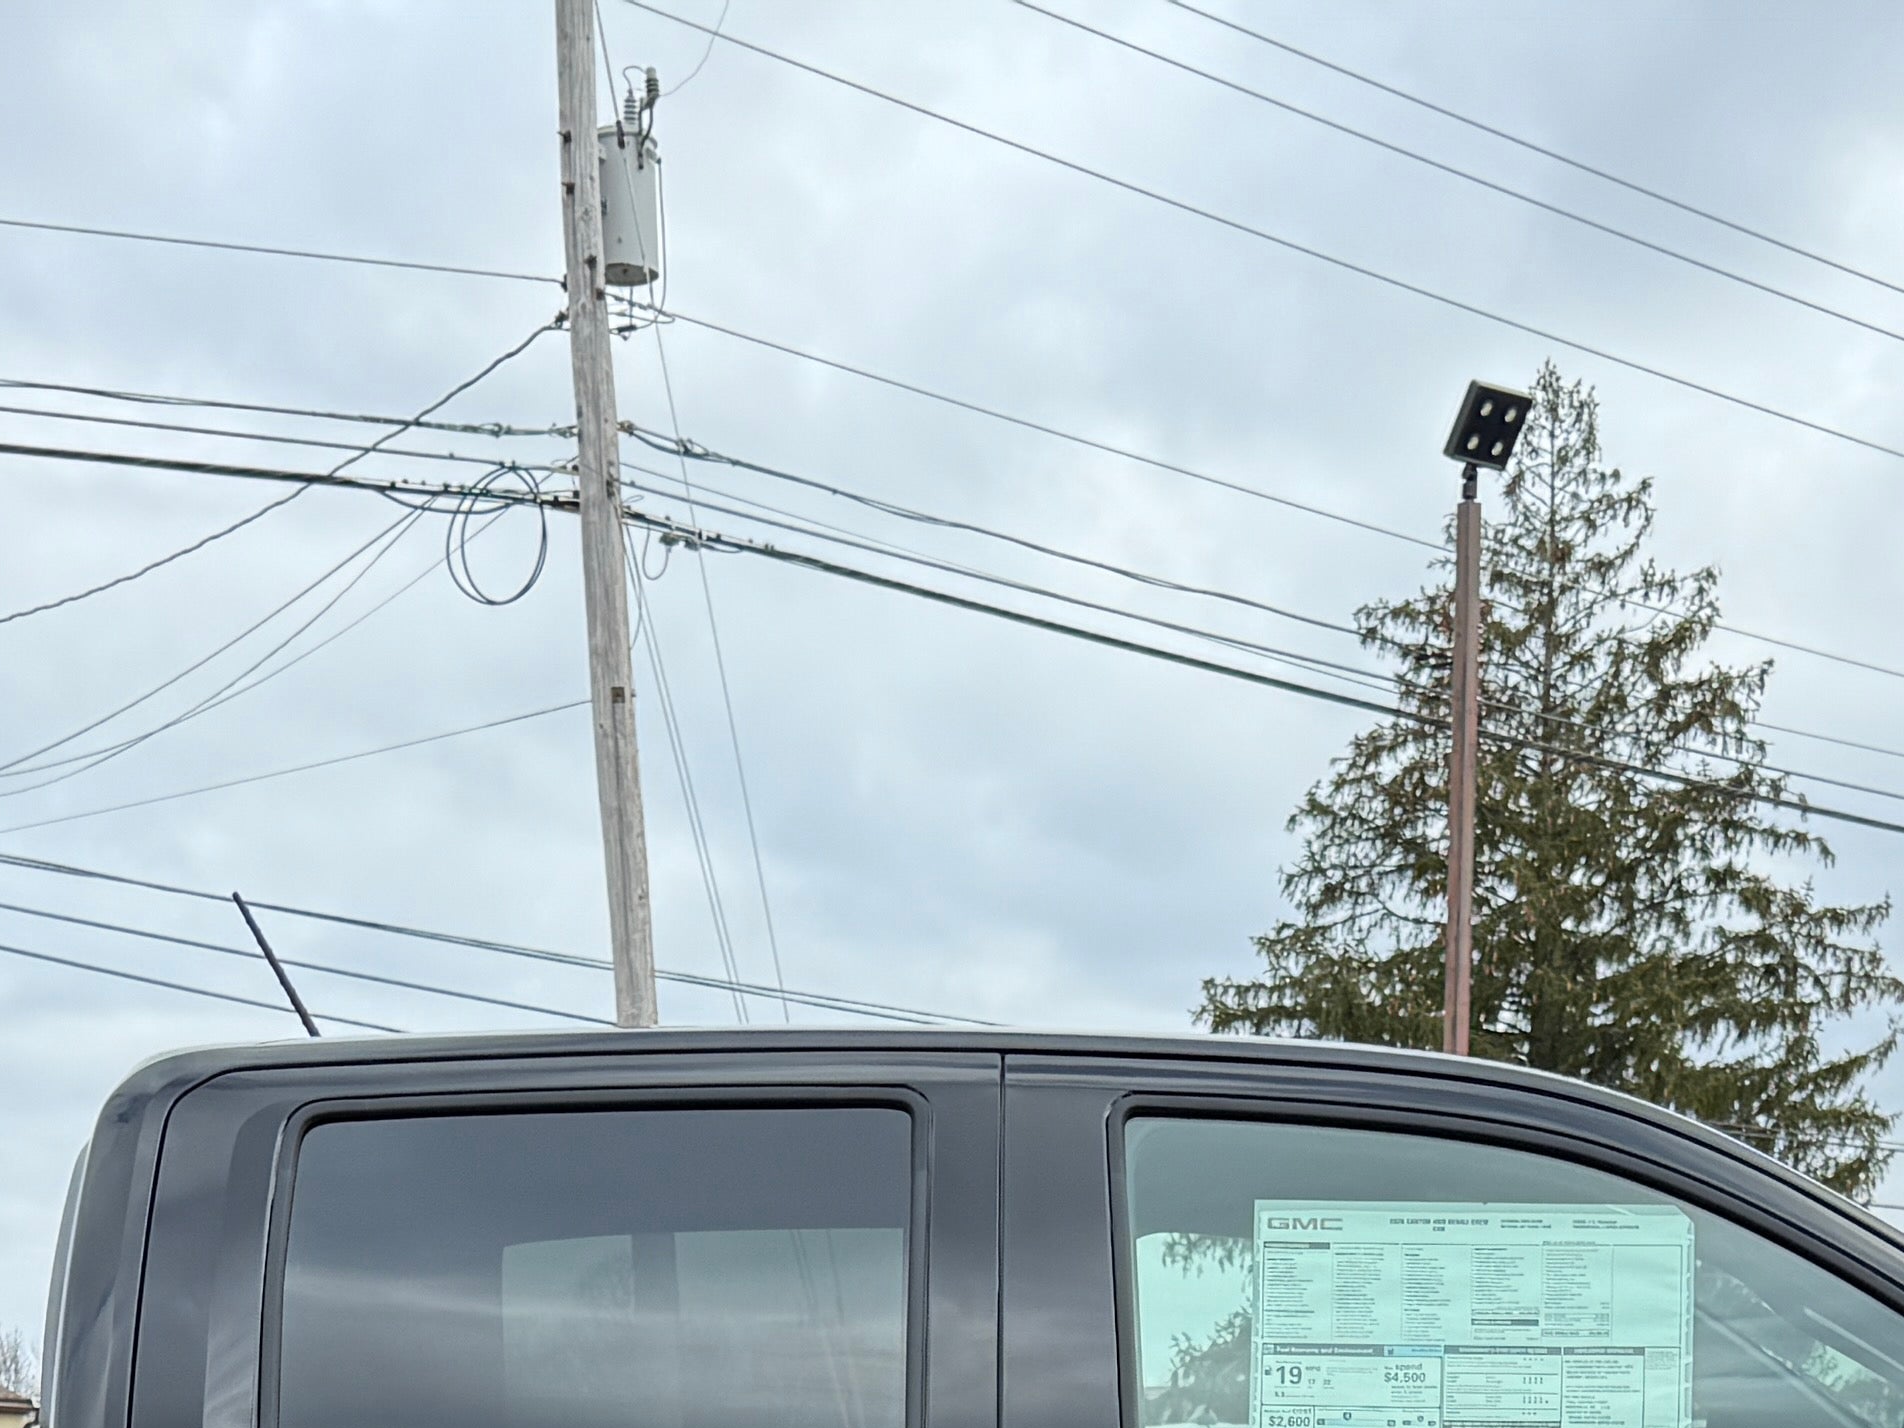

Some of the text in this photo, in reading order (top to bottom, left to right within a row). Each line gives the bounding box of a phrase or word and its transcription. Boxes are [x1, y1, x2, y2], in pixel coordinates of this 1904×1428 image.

[1267, 1217, 1343, 1231] GMC
[1276, 1365, 1302, 1385] 19
[1384, 1372, 1426, 1383] $4,500
[1268, 1416, 1310, 1428] $2,600
